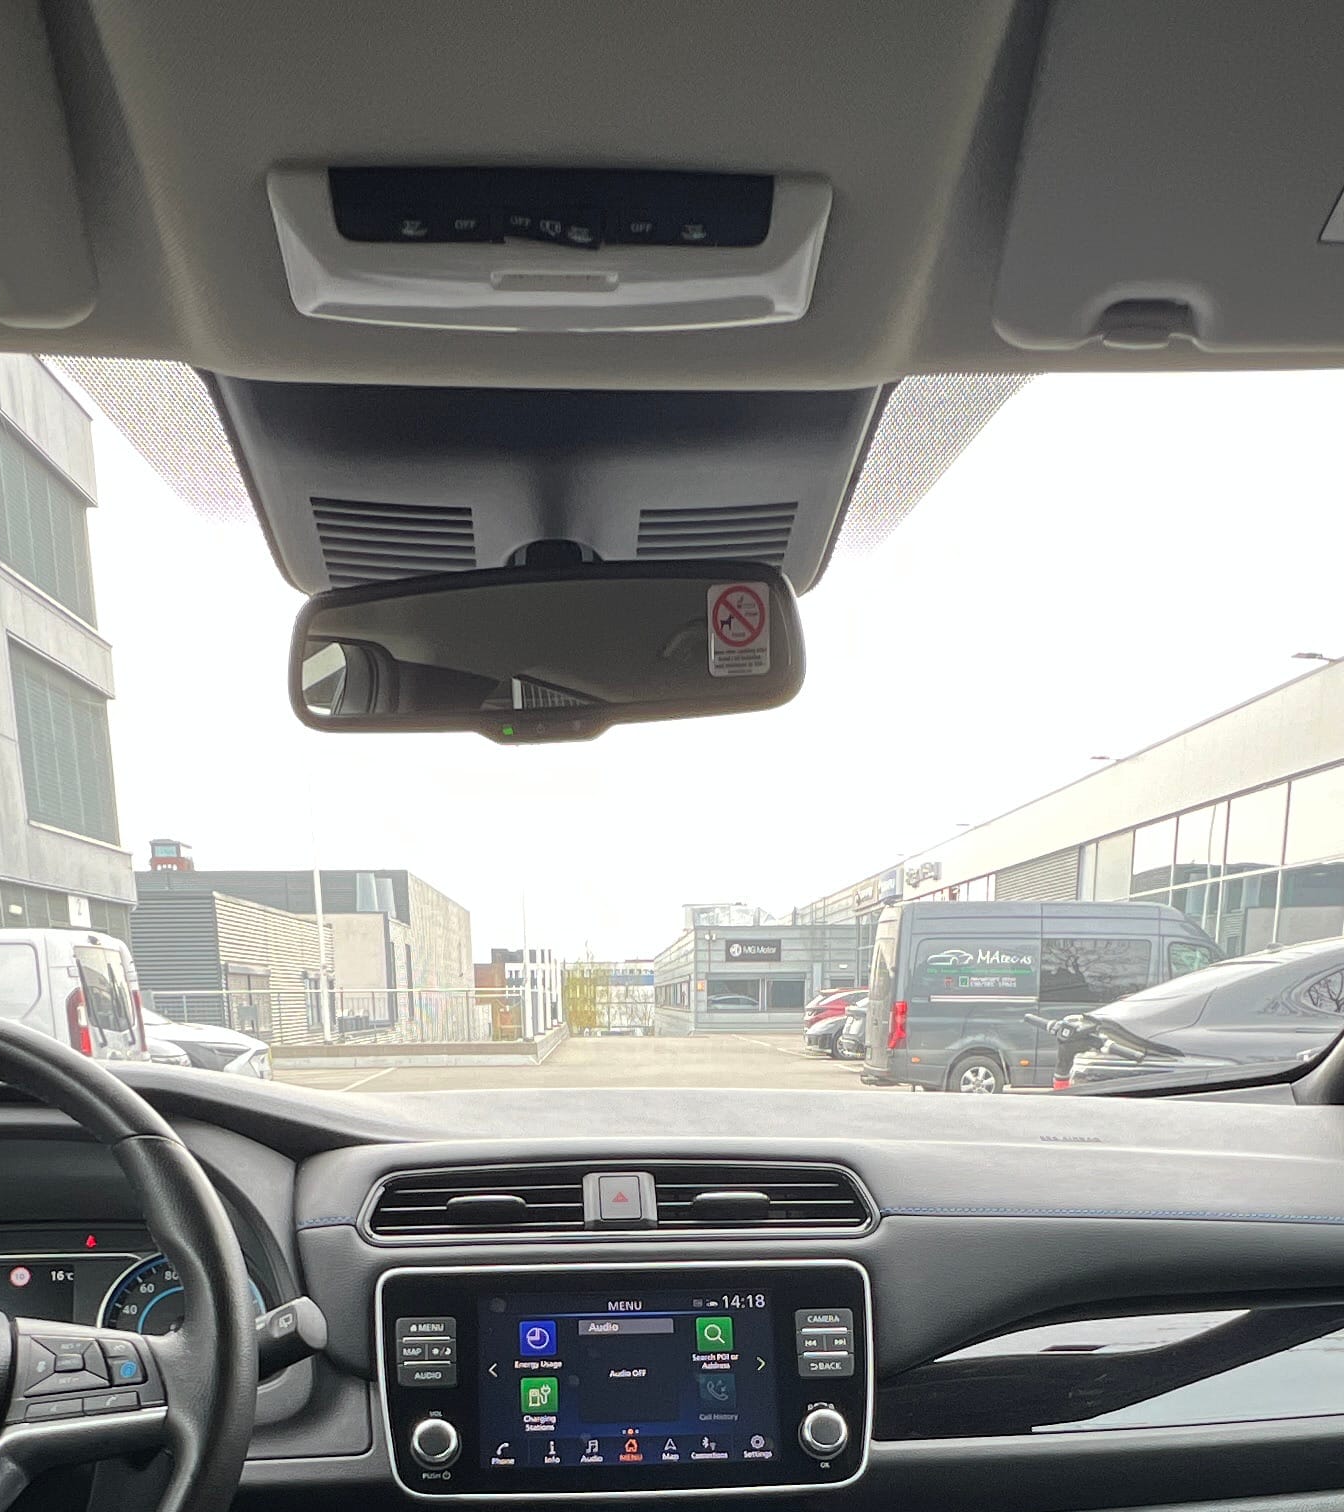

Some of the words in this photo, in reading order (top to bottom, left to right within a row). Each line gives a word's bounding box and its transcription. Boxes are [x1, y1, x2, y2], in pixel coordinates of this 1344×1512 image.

[164, 1270, 179, 1281] 80
[139, 1283, 155, 1294] 60
[607, 1301, 643, 1311] MENU
[722, 1294, 766, 1309] 14:18
[122, 1304, 138, 1315] 40
[807, 1314, 840, 1323] CAMERA
[417, 1323, 445, 1332] MENU
[588, 1322, 619, 1332] Audio
[402, 1347, 423, 1356] MAP
[818, 1361, 843, 1370] BACK
[414, 1371, 442, 1380] AUDIO
[609, 1369, 632, 1378] Audio
[632, 1368, 647, 1377] OFF
[580, 1454, 604, 1464] Audio
[743, 1450, 773, 1460] Settings
